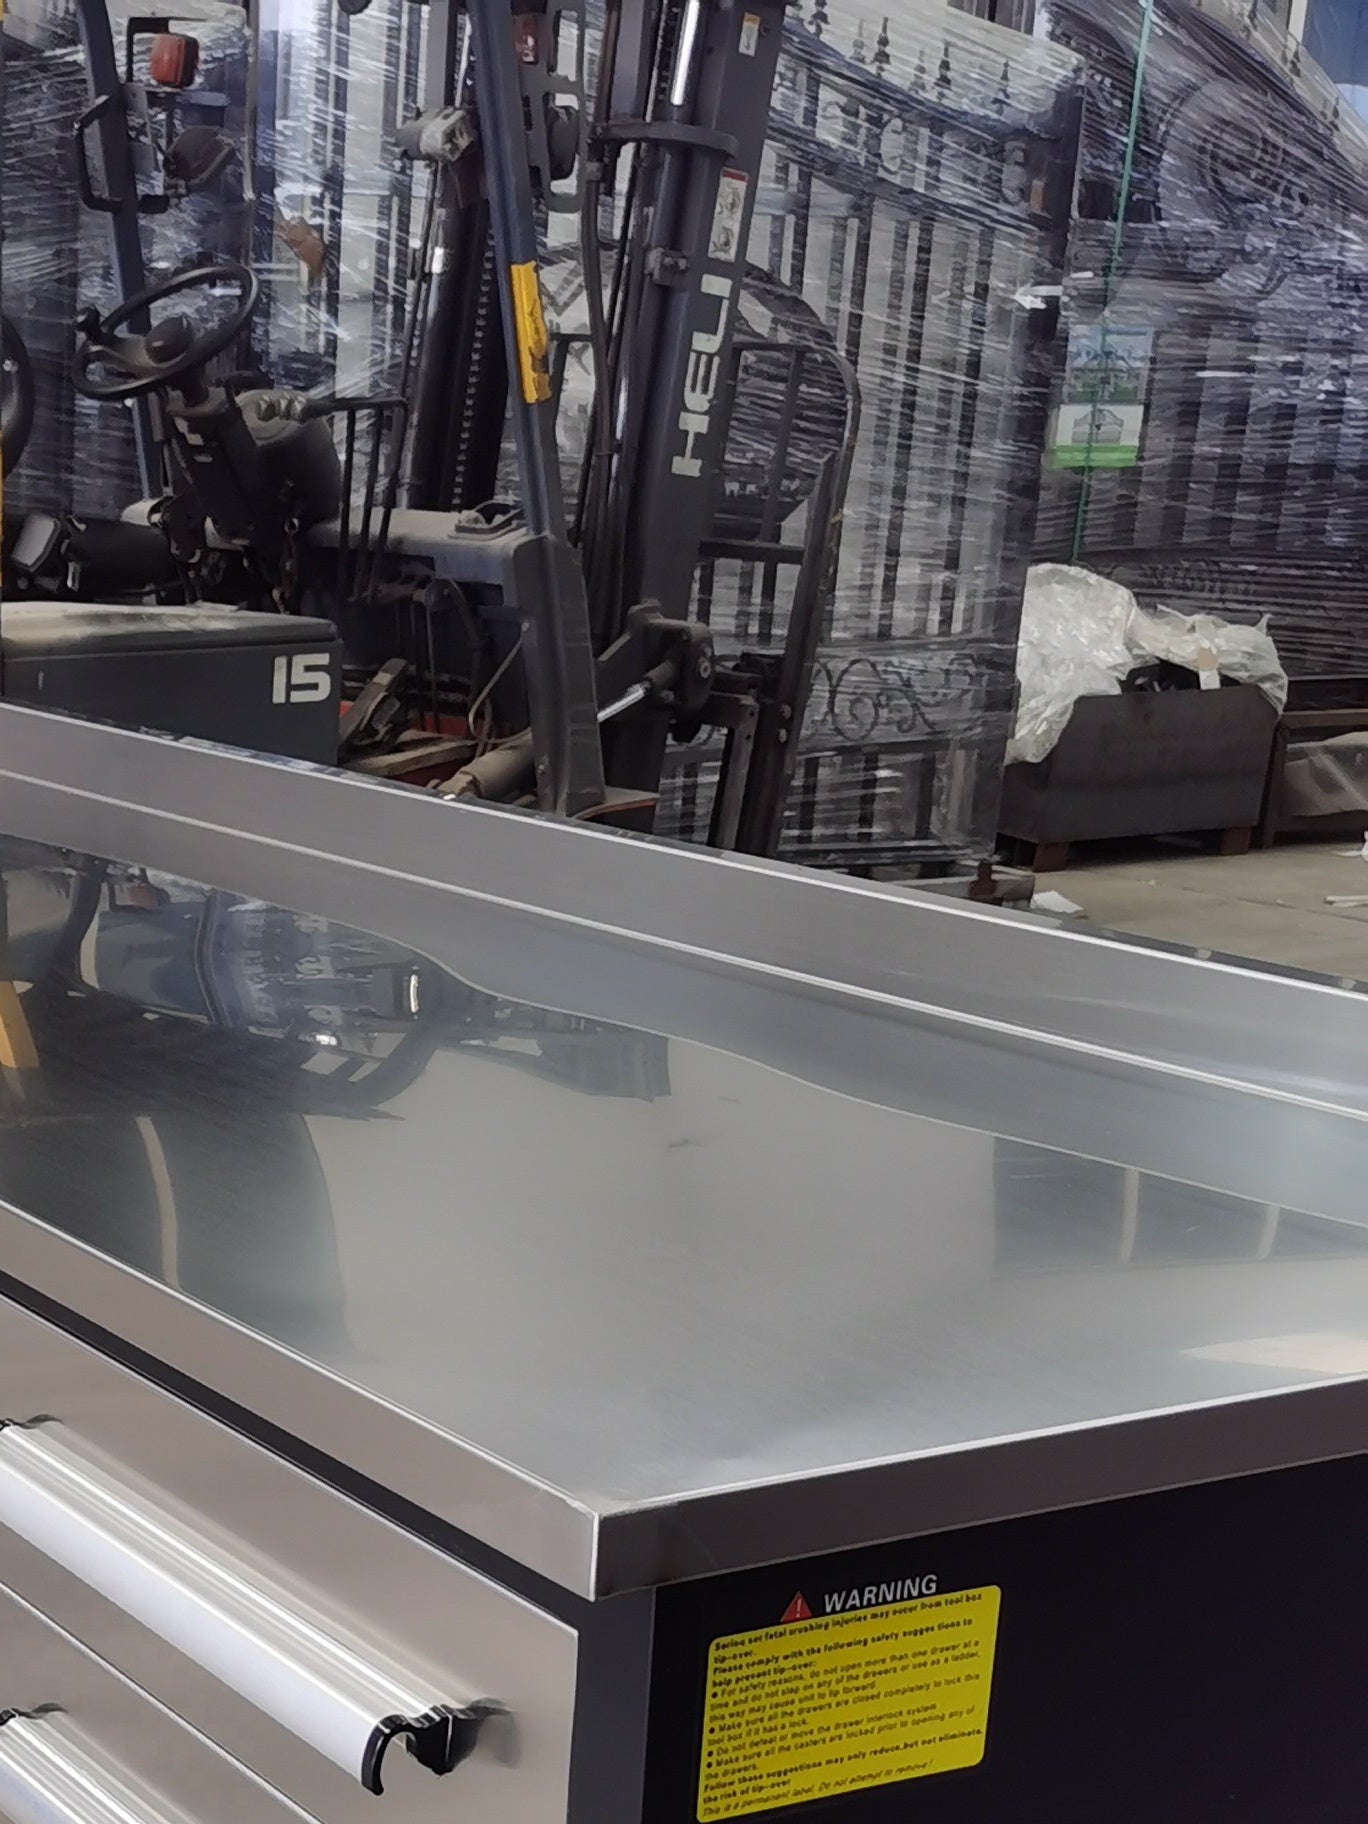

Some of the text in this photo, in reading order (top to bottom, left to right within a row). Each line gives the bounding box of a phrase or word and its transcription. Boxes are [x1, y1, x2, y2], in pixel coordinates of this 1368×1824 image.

[671, 273, 732, 477] HELI
[272, 653, 331, 704] 15
[824, 1574, 938, 1613] WARNING
